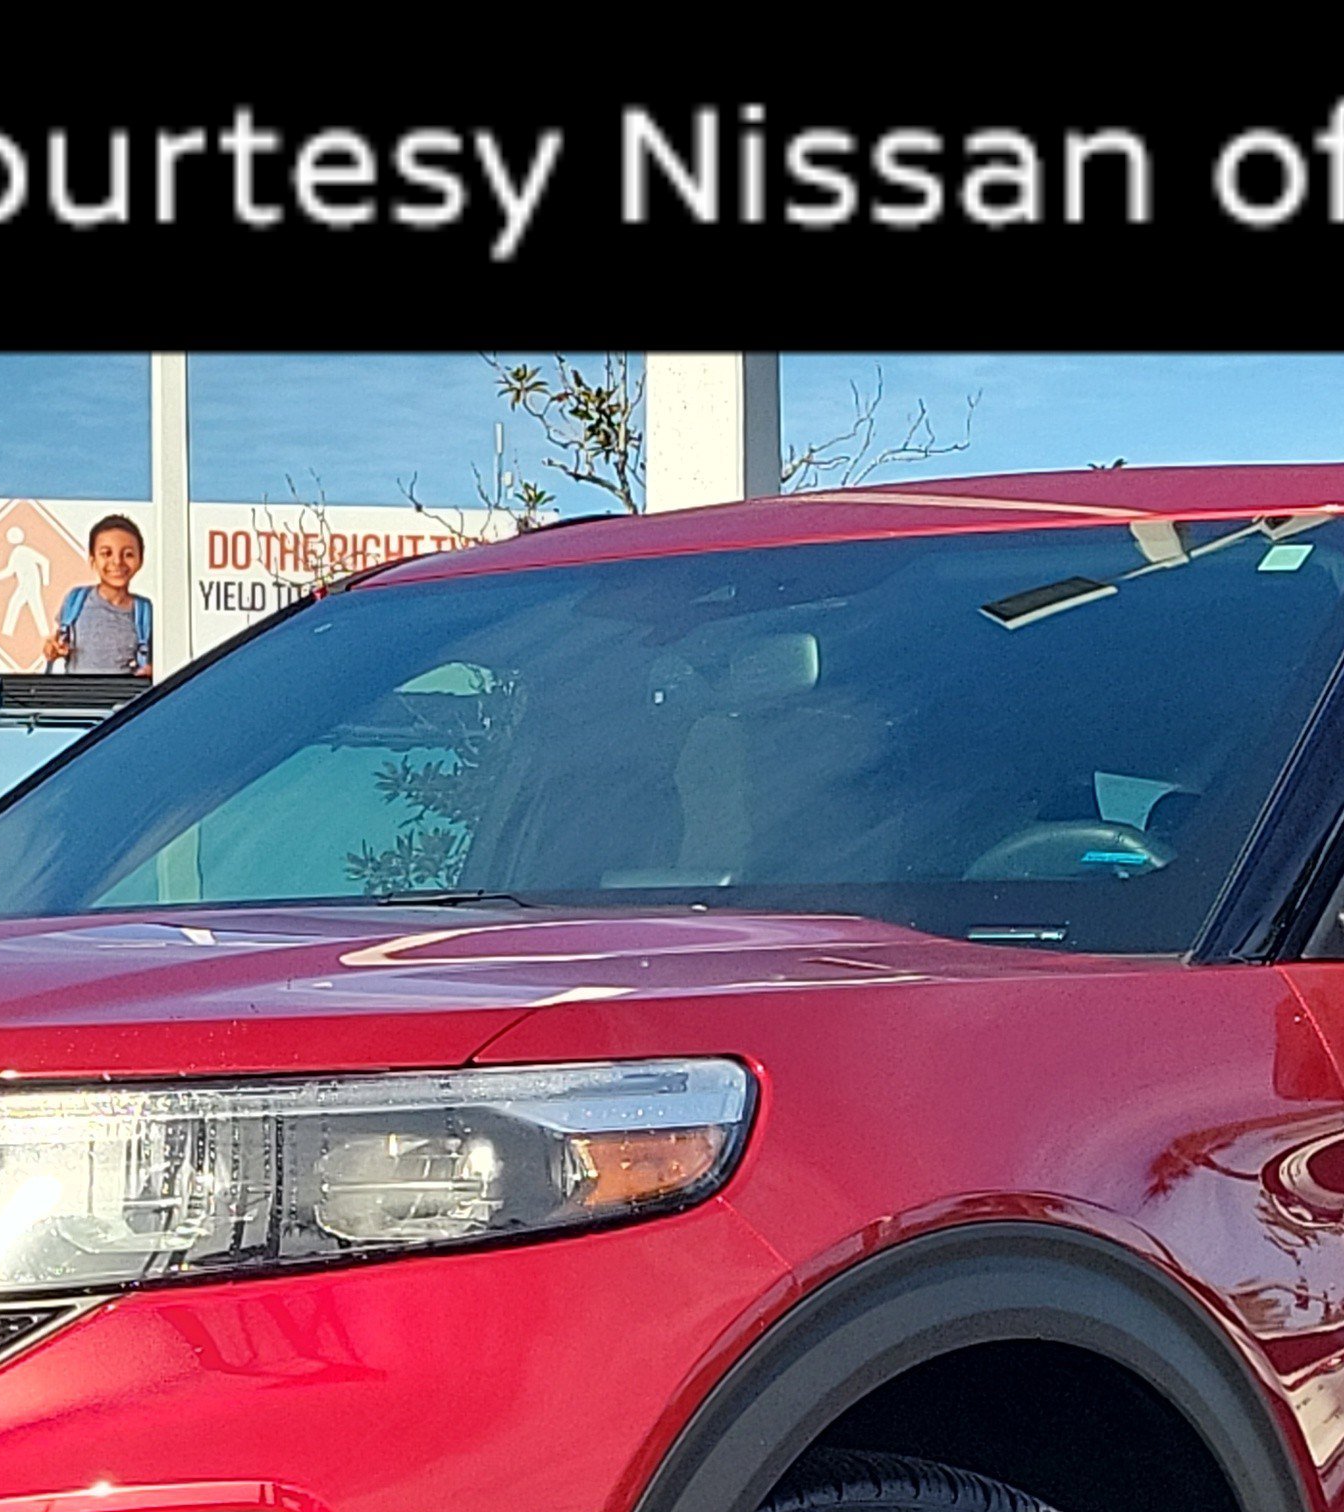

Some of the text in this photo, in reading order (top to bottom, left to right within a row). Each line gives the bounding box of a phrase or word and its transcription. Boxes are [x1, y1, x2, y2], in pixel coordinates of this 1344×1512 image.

[208, 530, 252, 570] DO
[258, 532, 320, 572] THE
[198, 580, 266, 612] YIELD
